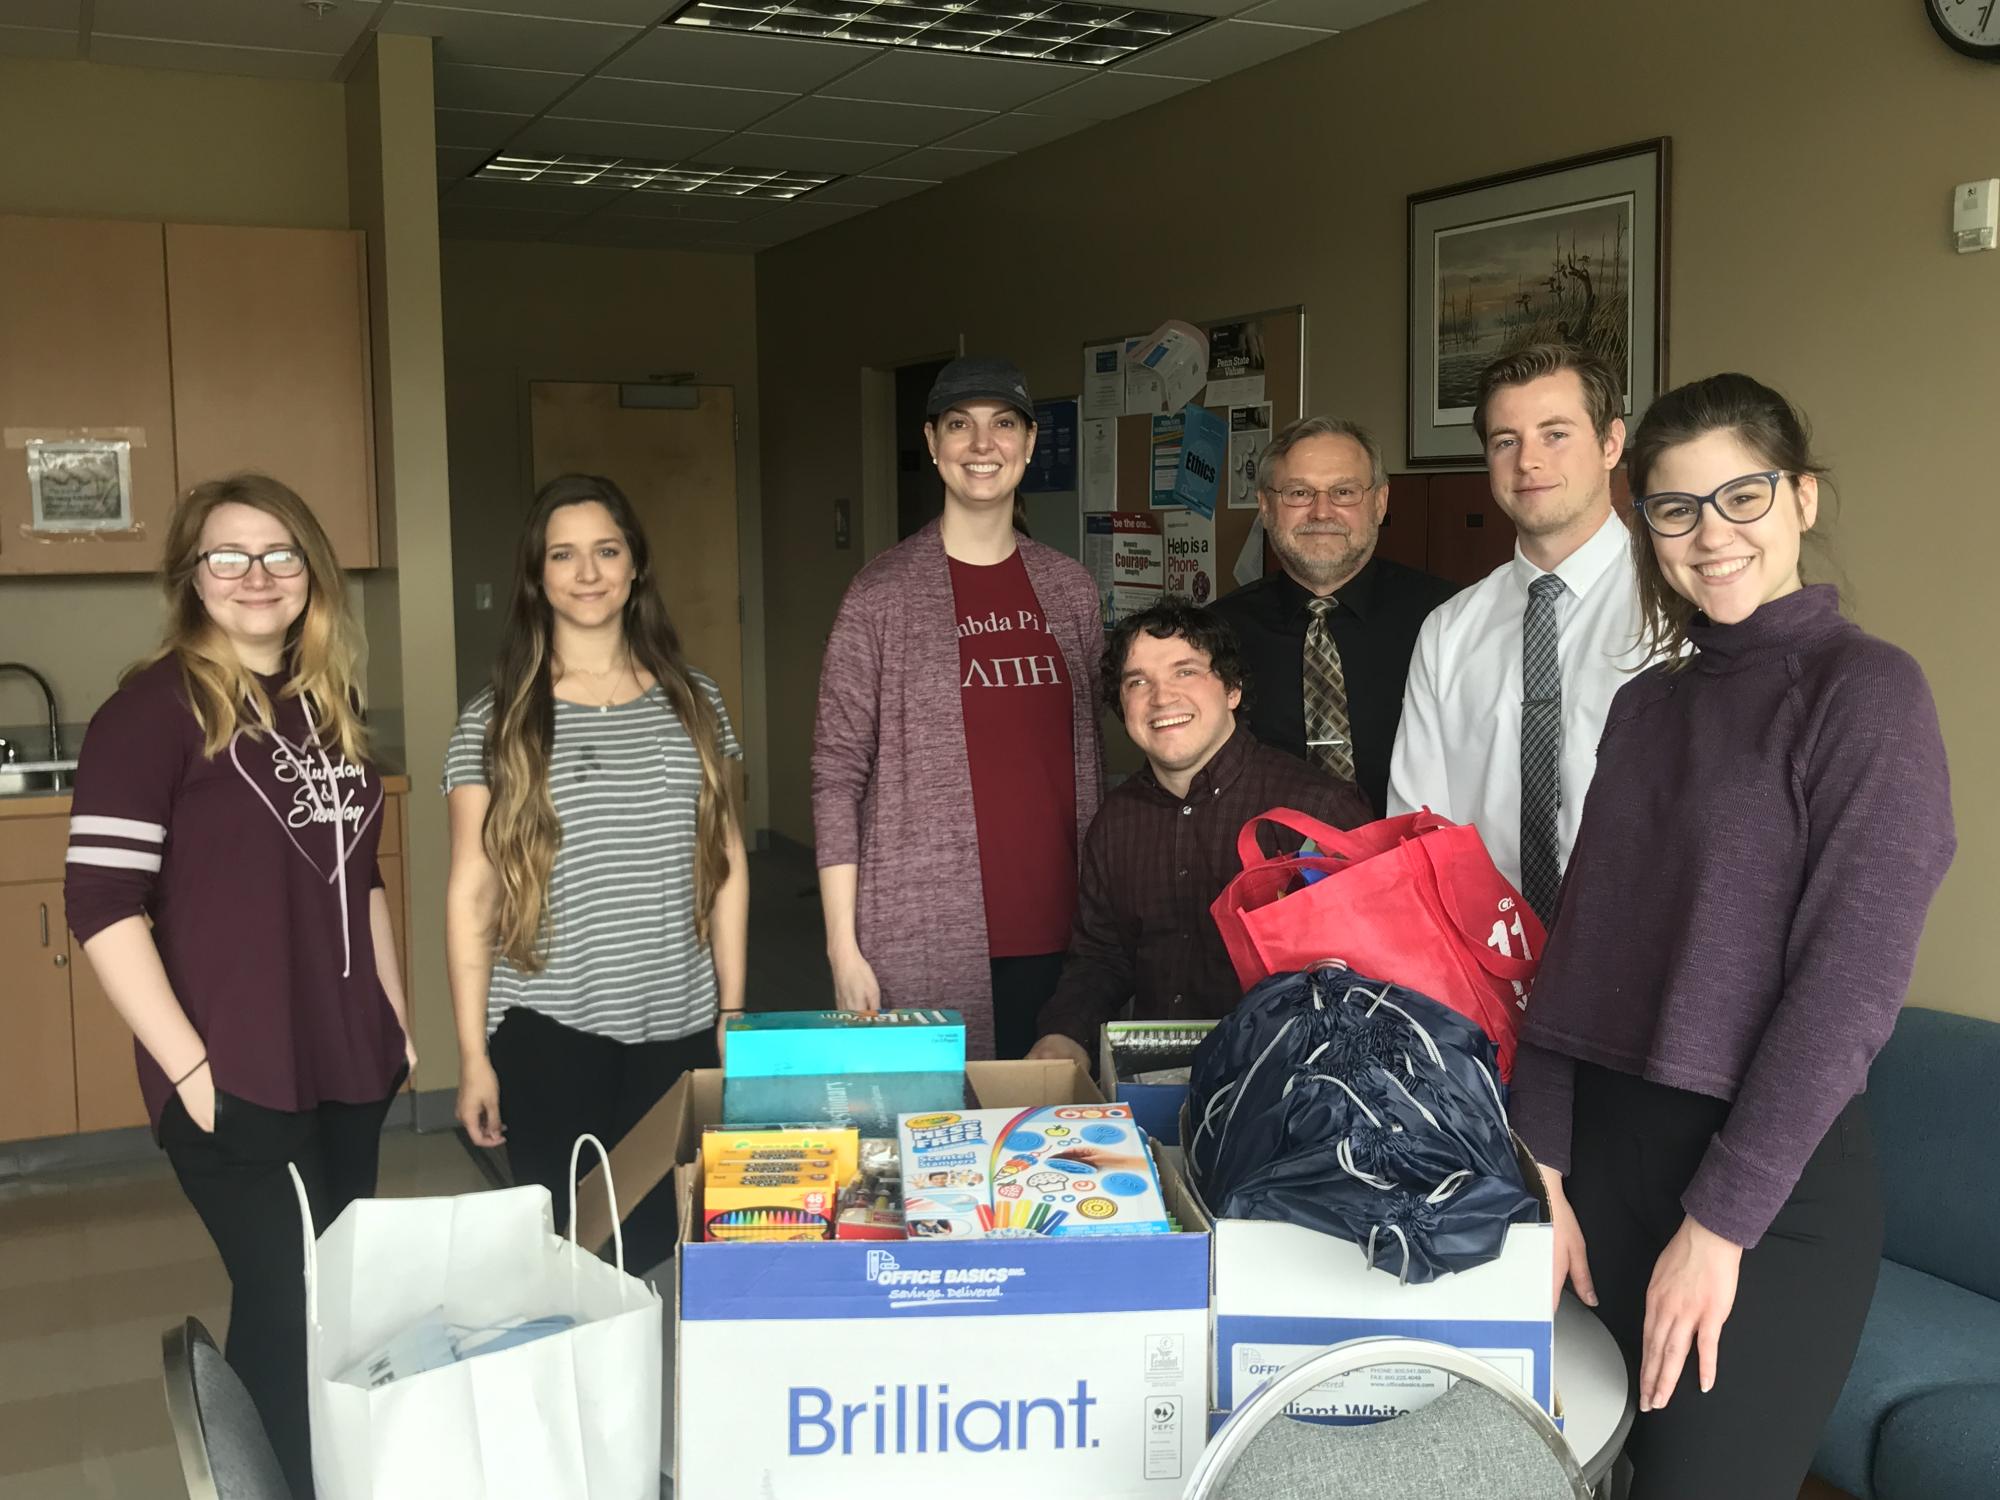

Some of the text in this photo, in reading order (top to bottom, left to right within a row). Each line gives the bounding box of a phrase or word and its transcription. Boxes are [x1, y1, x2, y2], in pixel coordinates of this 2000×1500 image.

[1217, 356, 1250, 368] Penn State
[1185, 451, 1216, 484] Ethics
[1113, 518, 1122, 528] be
[1123, 518, 1135, 528] the
[1167, 537, 1189, 558] Help
[1190, 537, 1200, 553] is
[1201, 540, 1208, 553] a
[1115, 552, 1149, 570] Courage
[1167, 557, 1199, 572] Phone
[1167, 574, 1185, 591] Call
[1017, 610, 1040, 631] Pi
[320, 784, 336, 802] &
[912, 1121, 981, 1140] MESS
[914, 1131, 982, 1148] FREE
[918, 1151, 976, 1162] Scented
[918, 1159, 977, 1168] Stampers
[878, 1270, 942, 1285] OFFICE
[944, 1268, 1008, 1284] BASICS
[888, 1285, 1003, 1300] Savings. Delivered.
[788, 1379, 1100, 1456] Brilliant.
